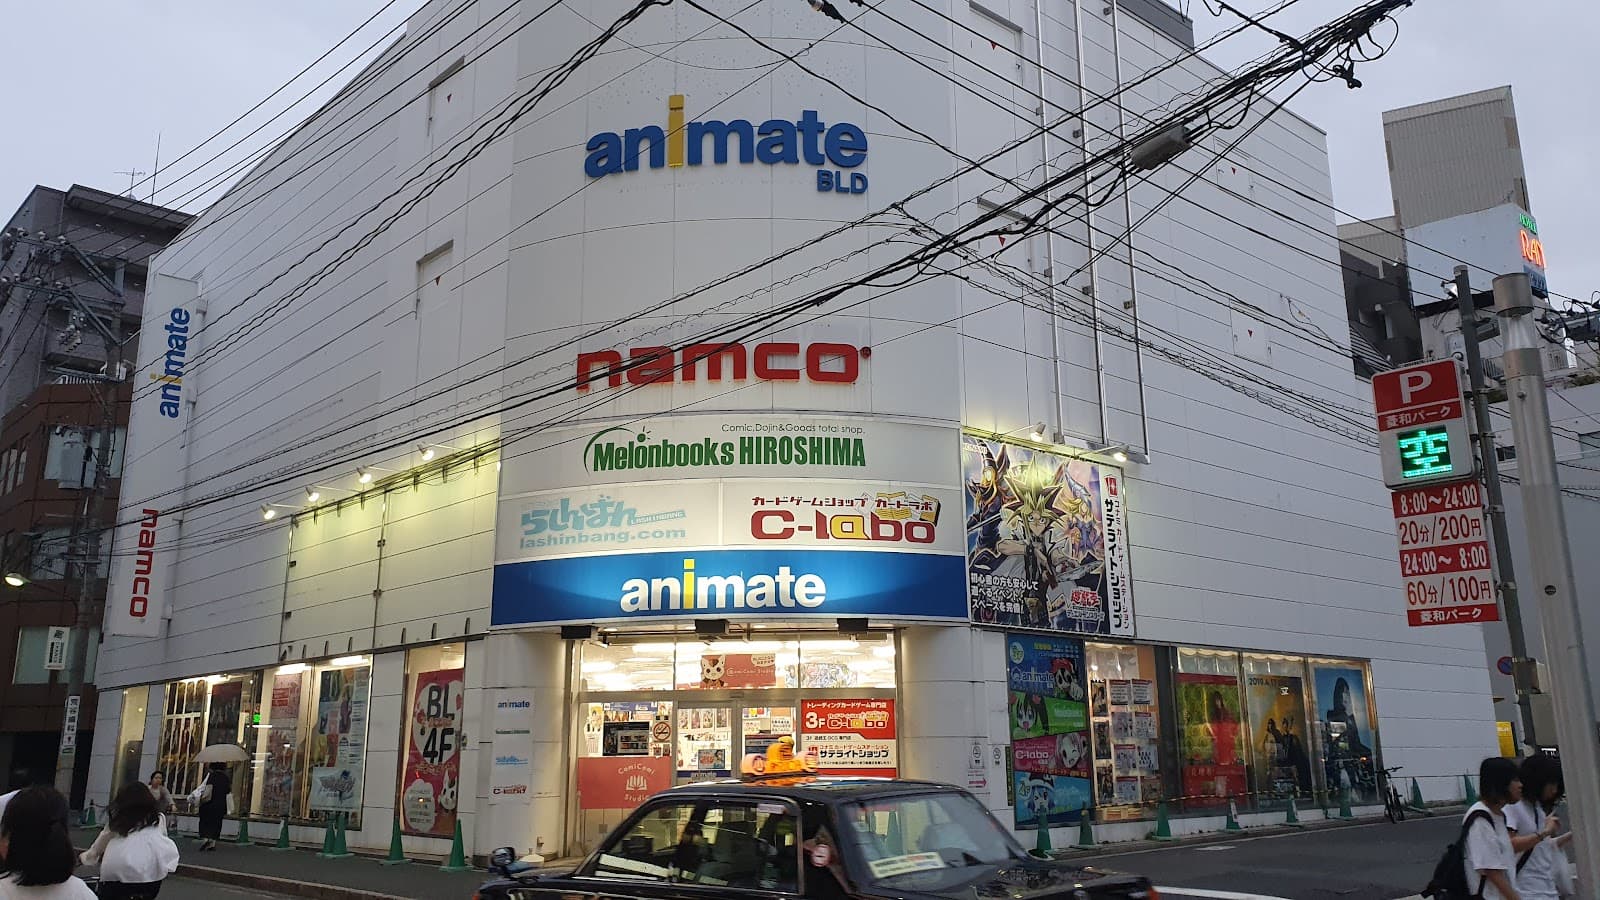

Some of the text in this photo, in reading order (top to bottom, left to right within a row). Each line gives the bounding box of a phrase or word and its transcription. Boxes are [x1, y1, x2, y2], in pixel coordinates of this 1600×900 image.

[584, 95, 868, 178] animate
[817, 170, 868, 194] BLD
[150, 307, 190, 418] animate
[576, 343, 859, 392] namco
[1399, 371, 1433, 404] P
[819, 424, 839, 433] total
[841, 425, 865, 435] shop.
[1386, 406, 1451, 428] 菱和パーク
[593, 435, 866, 471] Melonbooks HIROSHIMA
[1398, 431, 1453, 478] 空
[520, 494, 637, 536] らしんばん
[751, 496, 934, 511] カードゲームショップ カードラボ
[519, 528, 687, 550] lashinbang.com
[751, 510, 935, 543] C-labo
[1399, 514, 1482, 545] 20分/200円
[129, 508, 159, 618] namco
[1105, 498, 1123, 628] サテライトショップ
[620, 559, 827, 613] animate
[1406, 576, 1491, 606] 60分/100円
[1420, 607, 1482, 623] 菱和パーク
[427, 684, 455, 721] BL
[804, 711, 826, 729] 3F
[423, 727, 455, 764] 4F
[820, 750, 889, 758] サテライトショップ
